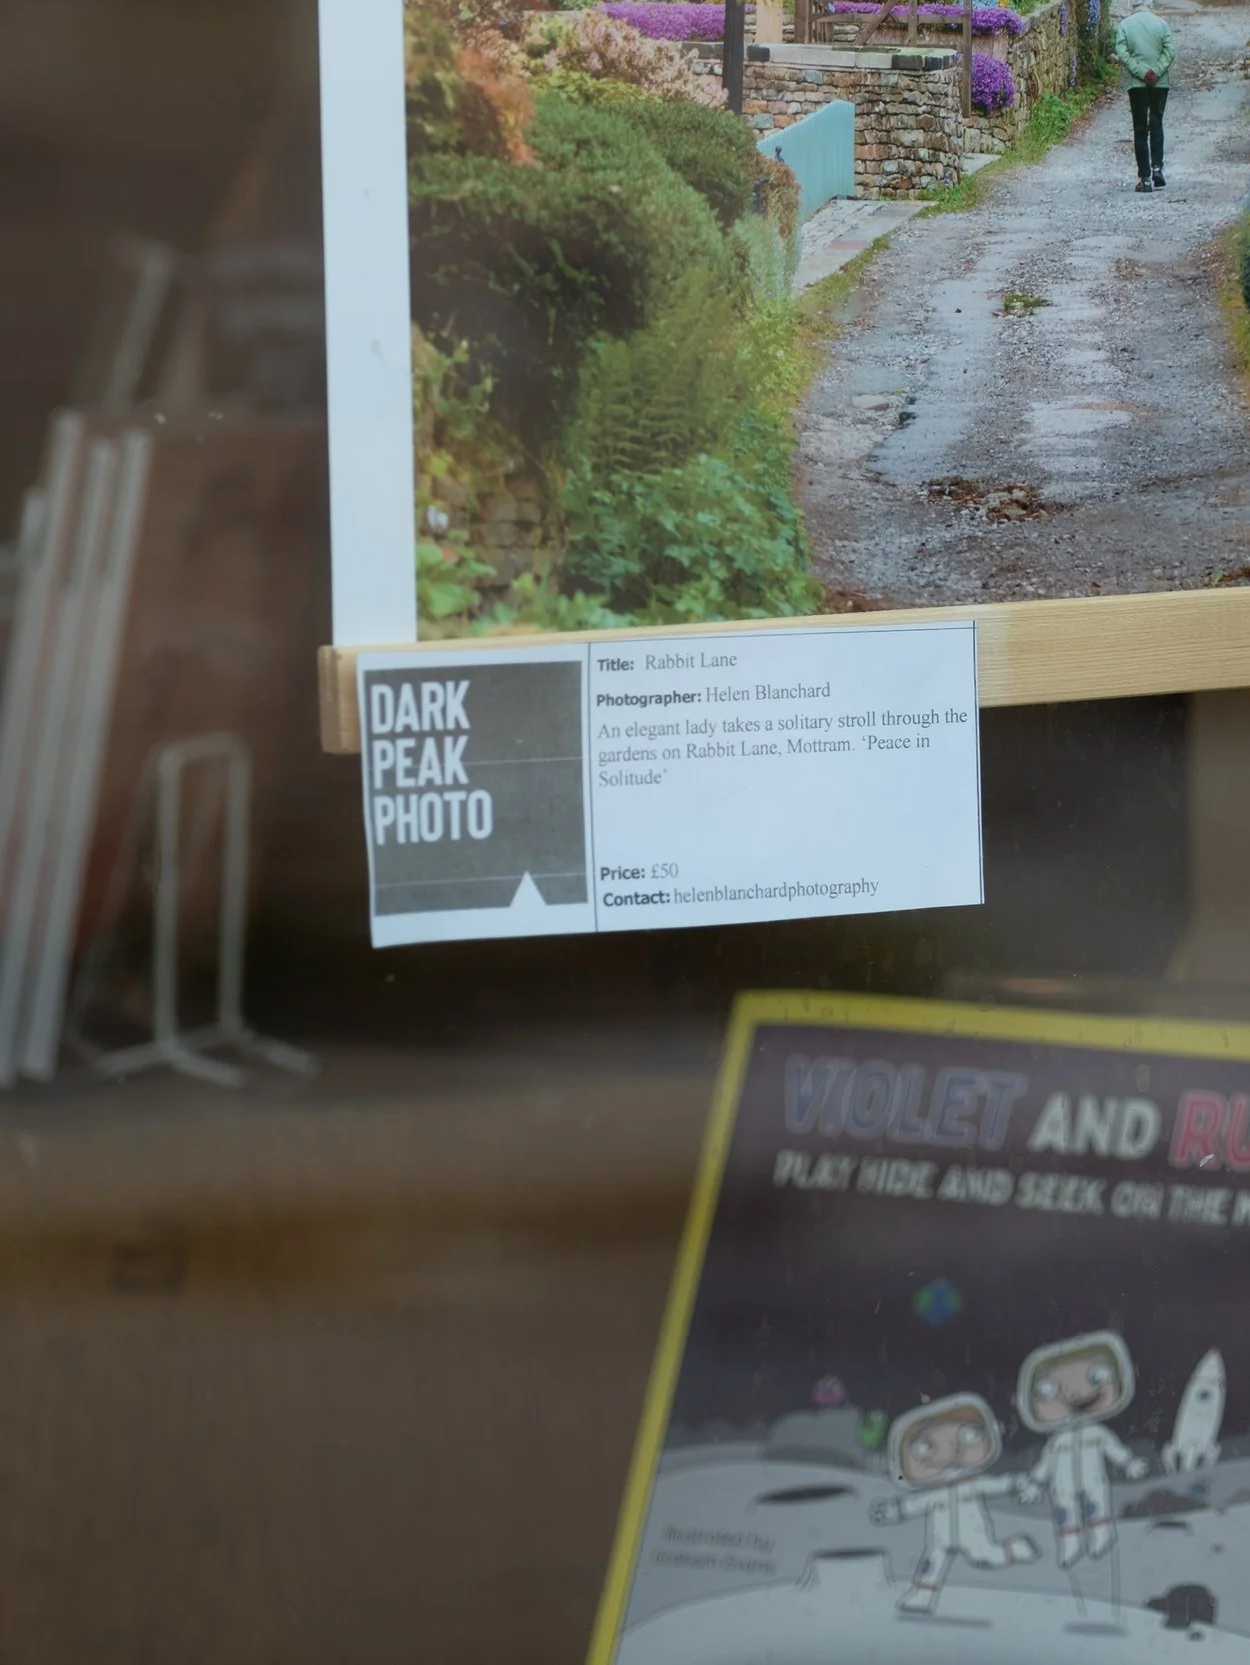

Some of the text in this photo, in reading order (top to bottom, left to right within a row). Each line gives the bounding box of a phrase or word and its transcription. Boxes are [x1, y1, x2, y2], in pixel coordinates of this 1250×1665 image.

[597, 652, 737, 672] Title: Rabbit Lane
[371, 679, 471, 734] DARK
[596, 682, 831, 708] Photographer: Helen Blanchard
[598, 708, 968, 741] An elegant lady takes a solitary stroll through the
[372, 735, 470, 789] PEAK
[598, 745, 657, 767] gardens
[662, 748, 681, 761] on
[686, 740, 736, 759] Rabbit
[741, 740, 782, 757] Lane,
[786, 736, 855, 755] Mottram.
[916, 732, 930, 748] in
[374, 789, 493, 846] PHOTO
[600, 862, 679, 881] Price: £50
[603, 878, 879, 907] Contact: helenblanchardphotography
[783, 1054, 1030, 1151] VIOLET
[1026, 1091, 1162, 1161] AND
[772, 1149, 856, 1190] PLAY
[856, 1156, 936, 1199] HIDE
[937, 1164, 1012, 1205] AND
[1014, 1170, 1107, 1215] SEEK
[1110, 1180, 1165, 1220] ON
[1166, 1185, 1231, 1225] THE
